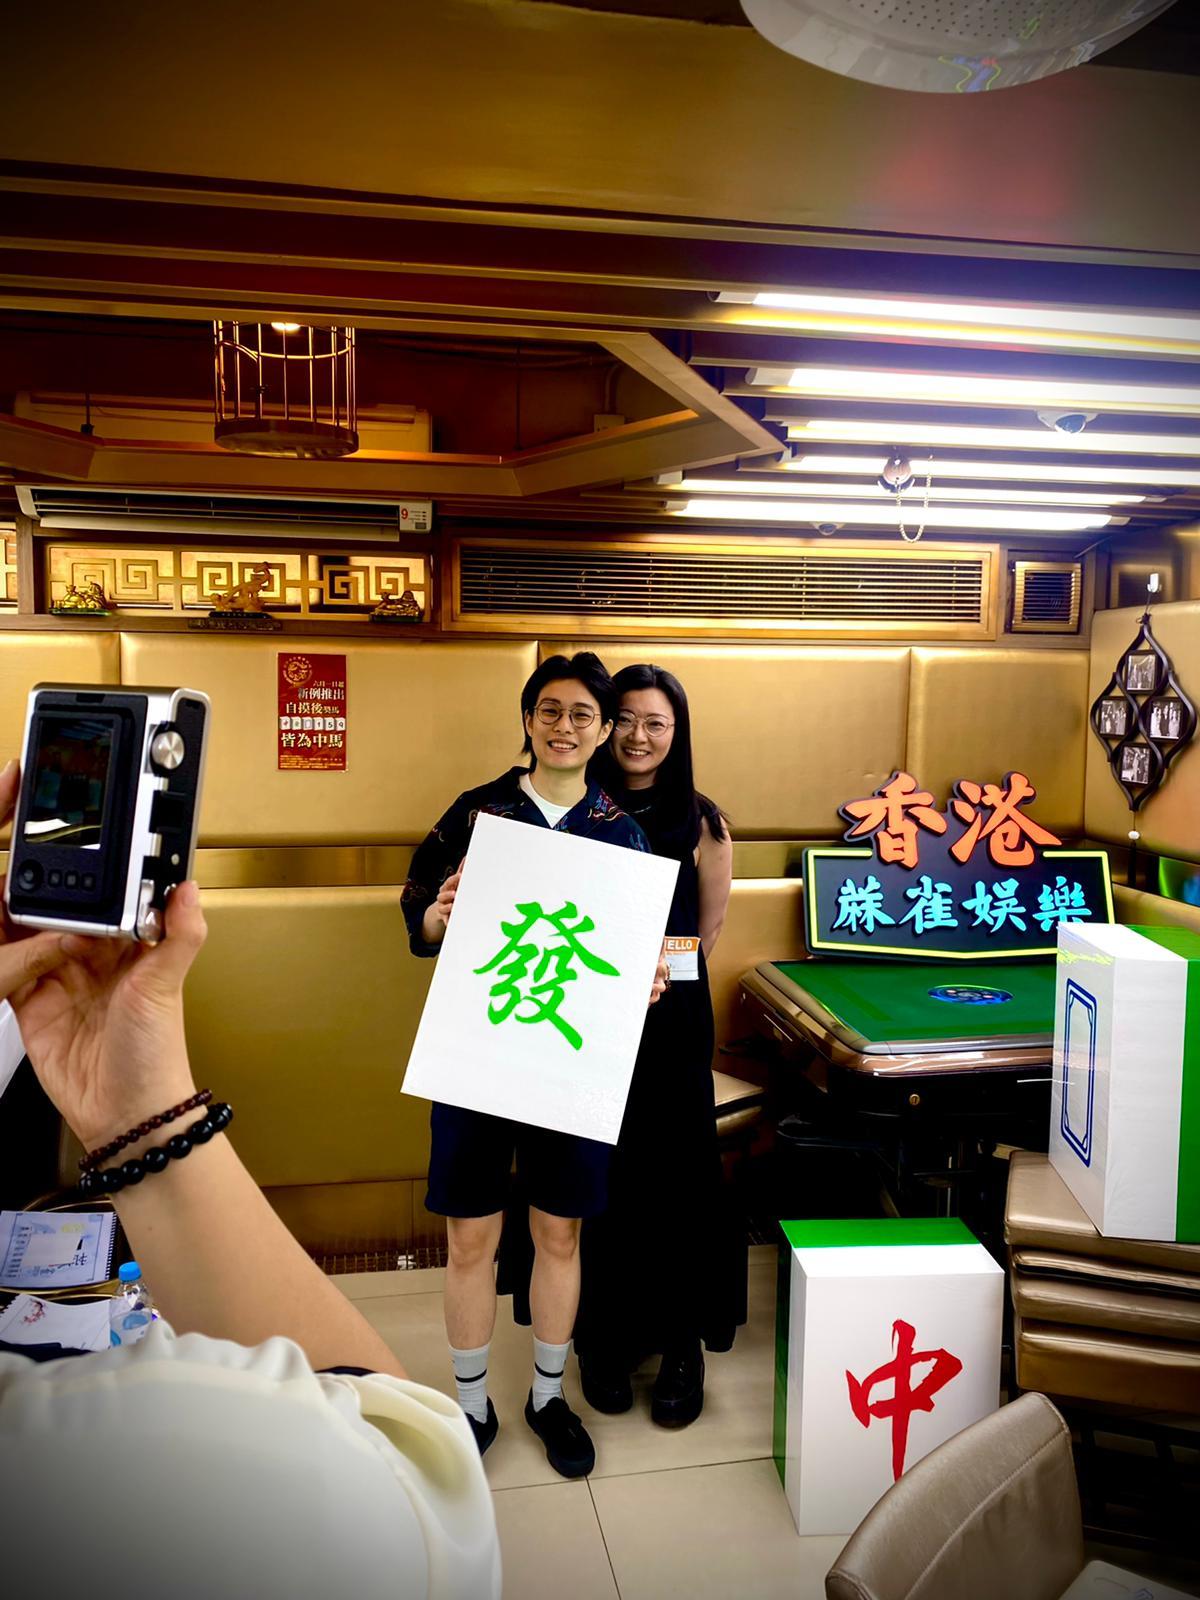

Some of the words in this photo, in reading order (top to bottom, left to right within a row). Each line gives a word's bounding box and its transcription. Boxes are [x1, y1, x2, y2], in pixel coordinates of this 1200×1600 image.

[401, 508, 408, 520] 9
[298, 687, 345, 701] 新例推出
[281, 732, 343, 748] 皆為中馬
[844, 771, 1063, 869] 香港
[472, 900, 621, 1051] 發
[845, 1318, 963, 1481] 中
